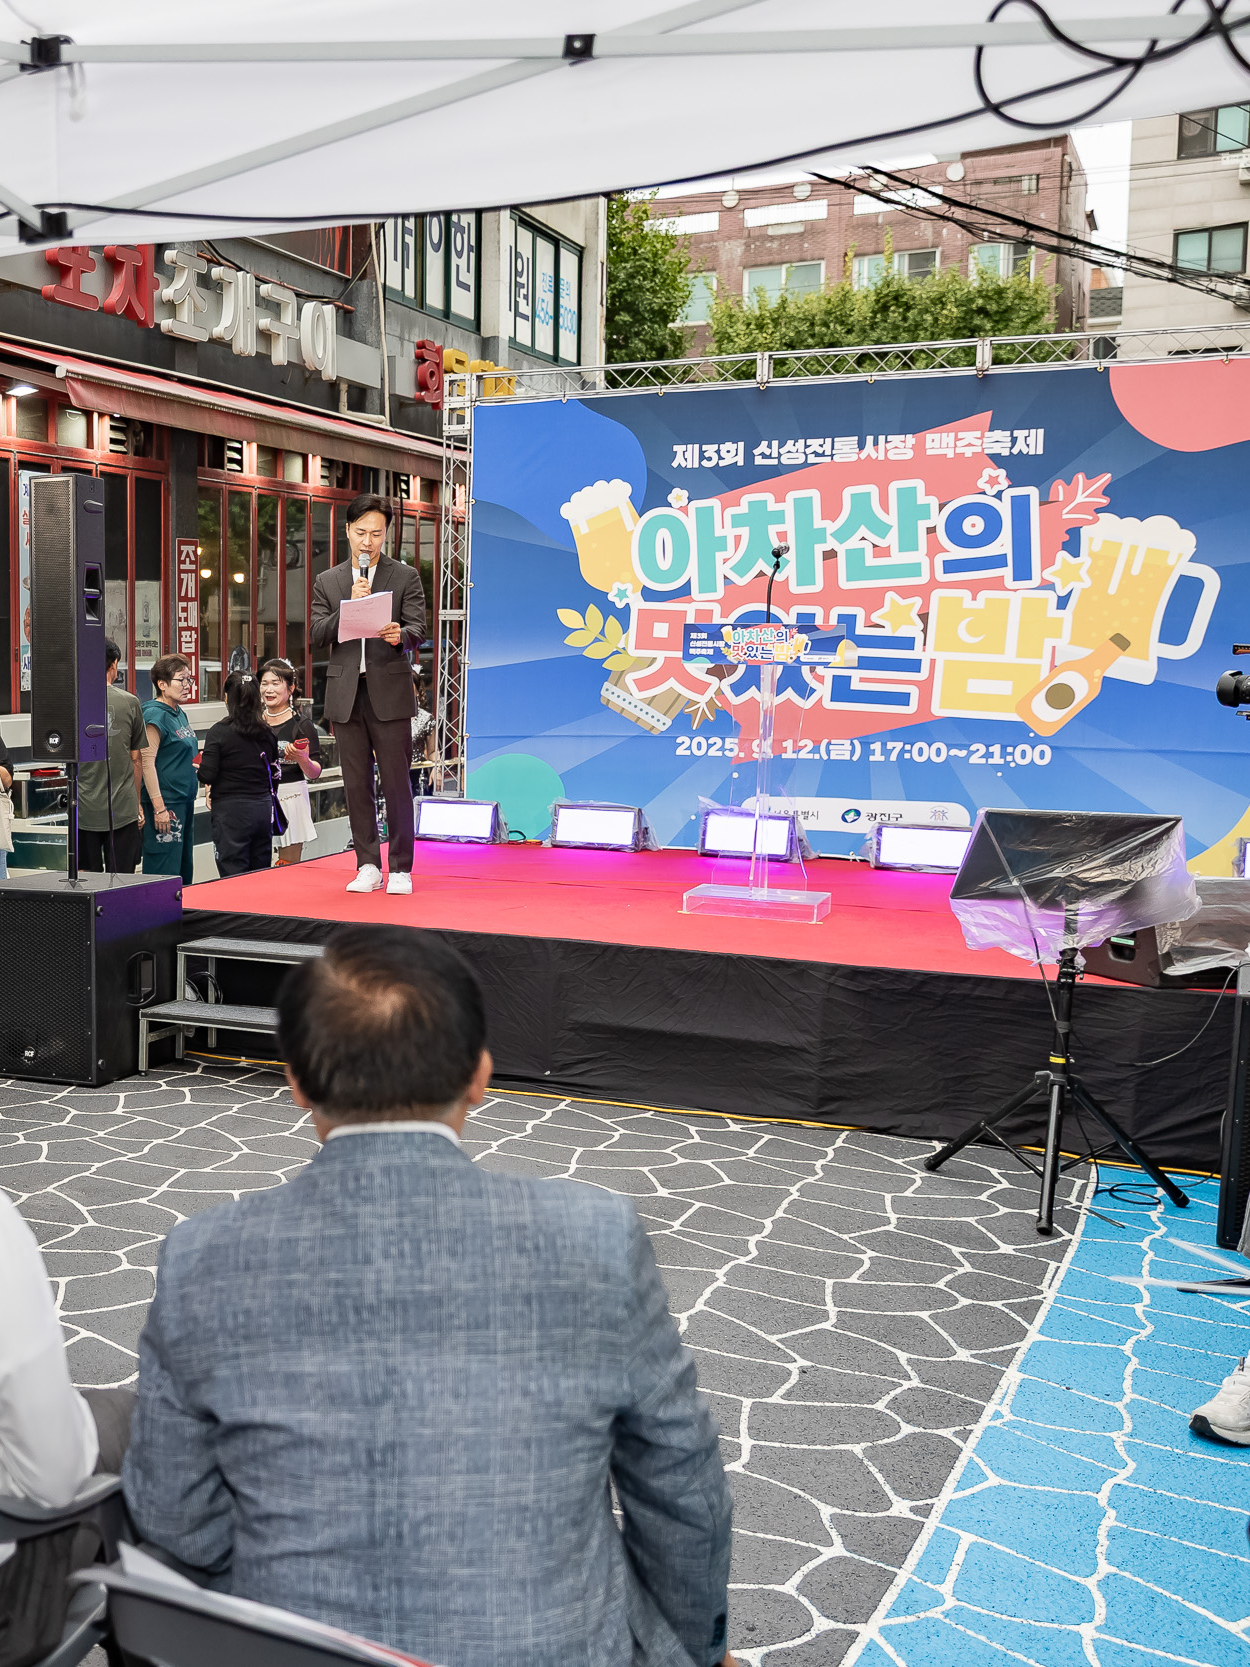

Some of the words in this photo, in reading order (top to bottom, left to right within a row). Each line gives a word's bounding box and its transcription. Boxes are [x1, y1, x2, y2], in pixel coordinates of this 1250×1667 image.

[671, 440, 745, 469] 제3회
[752, 434, 916, 466] 신성전통시장
[924, 428, 1045, 459] 맥주축제
[633, 479, 1040, 599] 아차산의
[732, 627, 789, 643] 아차산의
[675, 736, 744, 758] 2025.
[868, 740, 1052, 766] 17:00~21:00
[865, 810, 903, 823] 광진구
